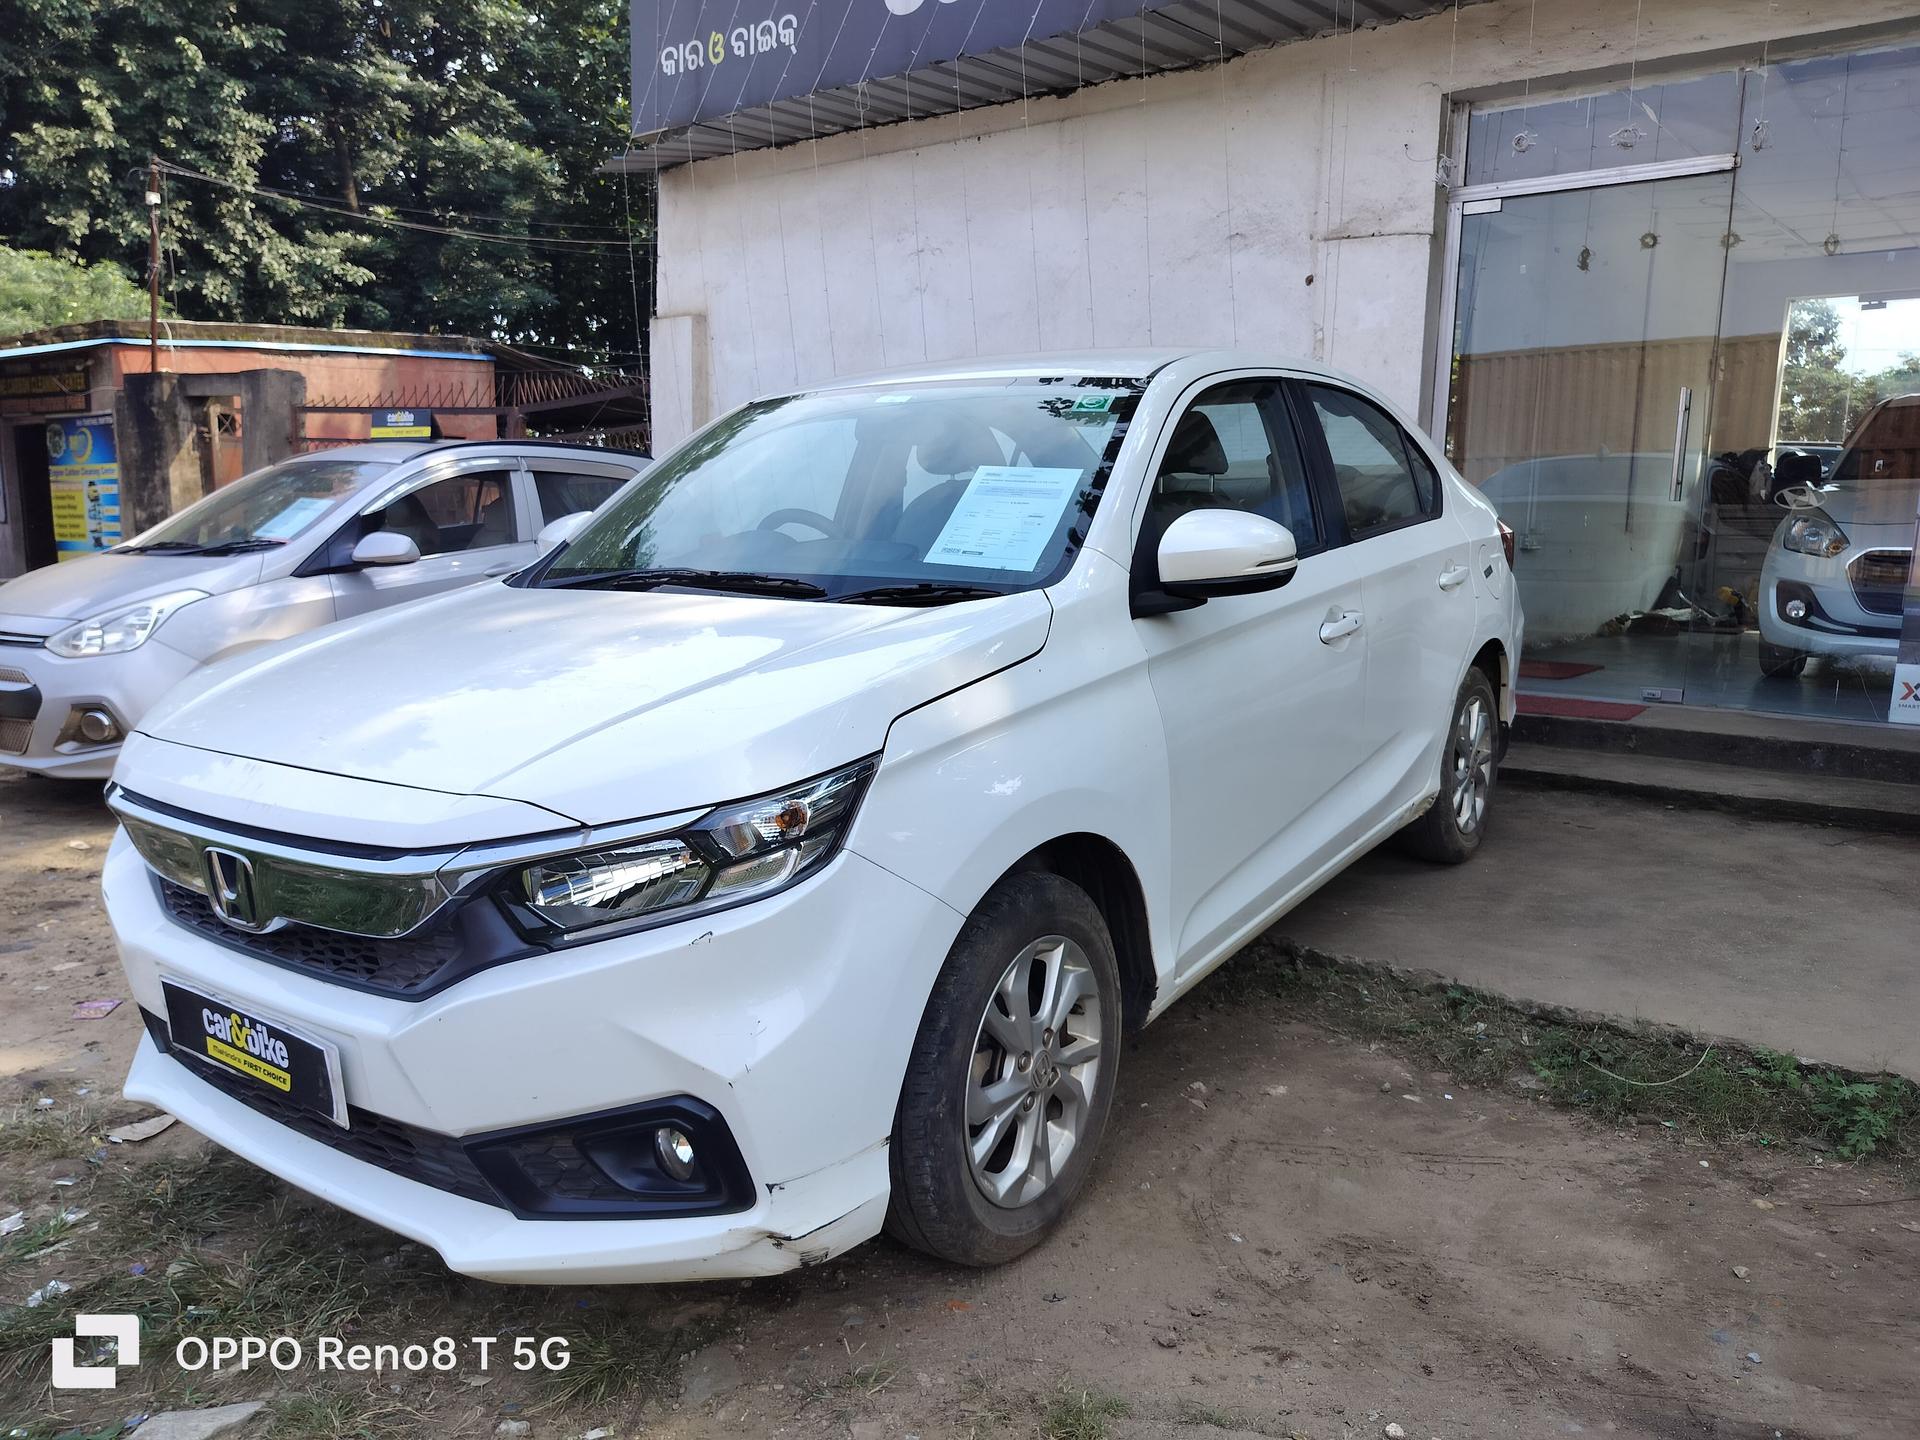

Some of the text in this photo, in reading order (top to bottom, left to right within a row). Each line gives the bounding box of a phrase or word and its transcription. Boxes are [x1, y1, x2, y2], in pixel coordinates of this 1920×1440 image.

[660, 14, 798, 77] କାର ଓ ବାଇକ୍
[202, 1008, 289, 1069] car&bike
[243, 1060, 262, 1073] FIRST
[263, 1068, 288, 1085] CHOICE
